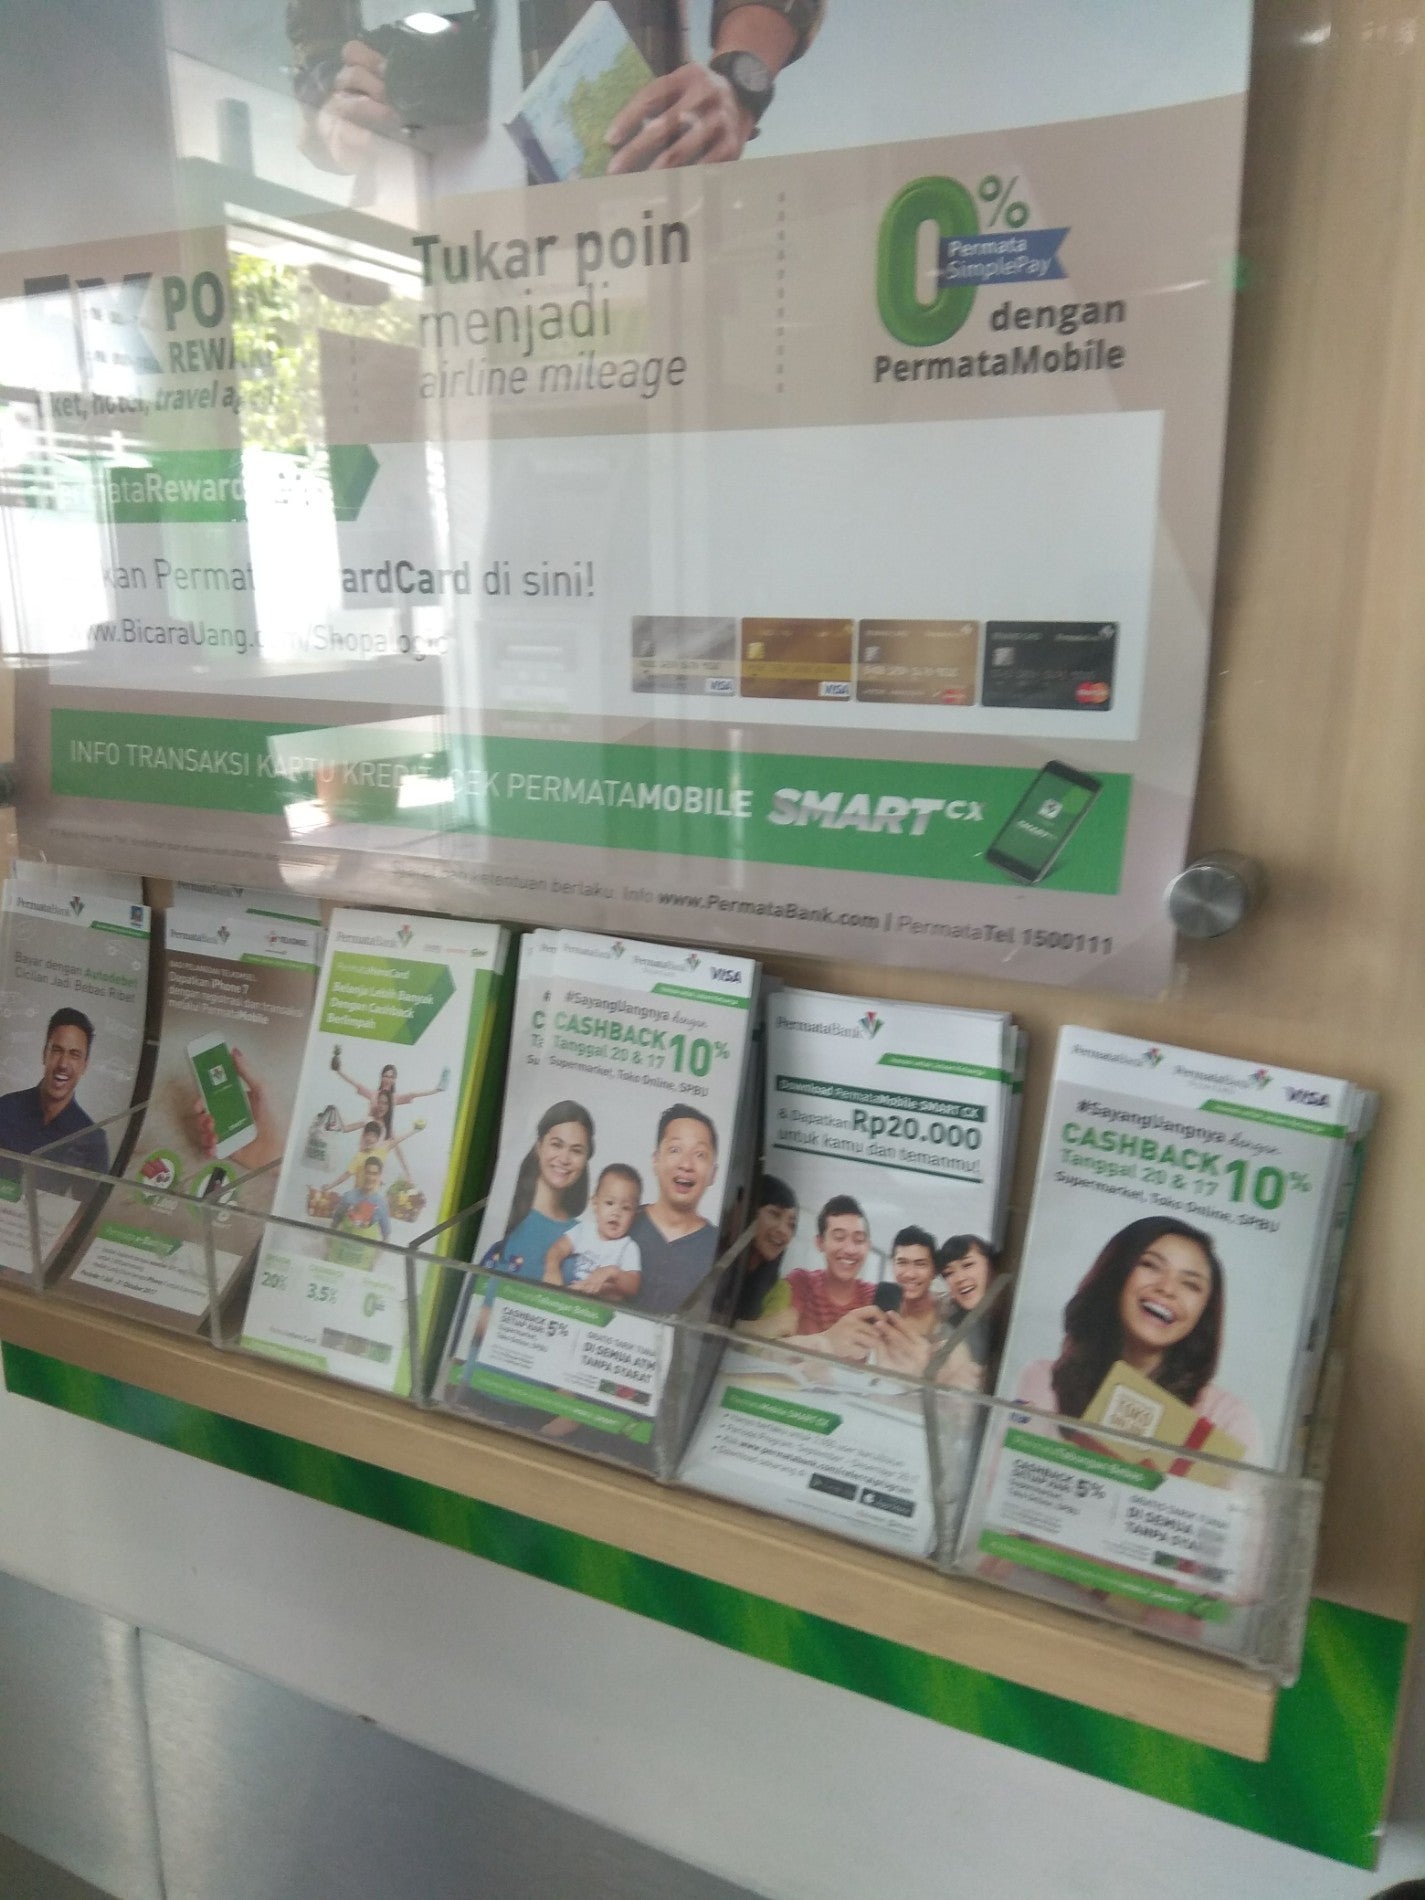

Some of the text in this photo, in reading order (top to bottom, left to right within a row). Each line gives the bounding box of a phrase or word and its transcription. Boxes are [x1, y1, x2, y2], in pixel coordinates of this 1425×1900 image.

[411, 210, 690, 288] Tukar poin
[950, 237, 1028, 258] Permata
[946, 255, 1052, 281] SimplePay
[418, 281, 612, 357] menjadi
[990, 301, 1127, 336] dengan
[420, 350, 688, 400] airline mileage
[873, 338, 1127, 384] PermataMobile
[155, 379, 219, 412] travel
[482, 560, 511, 596] di
[522, 560, 595, 598] sini!
[69, 739, 120, 765] INFO
[125, 743, 249, 777] TRANSAKSI
[256, 753, 338, 784] KARTU
[506, 772, 754, 819] PERMATAMOBILE
[767, 787, 947, 836] SMART
[657, 890, 880, 931] www.PermataBank.com
[899, 914, 1015, 943] PermataTel
[1022, 928, 1114, 955] 1500111
[711, 966, 742, 984] VISA
[553, 1011, 668, 1051] CASHBACK
[553, 1035, 607, 1059] Tanggal
[610, 1046, 629, 1063] 20
[648, 1053, 666, 1071] 17
[1284, 1086, 1331, 1108] VISA
[823, 1135, 865, 1153] kamu
[868, 1143, 897, 1158] dan
[852, 1108, 983, 1151] Rp20.000
[1060, 1121, 1221, 1176] CASHBACK
[1061, 1149, 1137, 1179] Tanggal
[1193, 1177, 1220, 1197] 17
